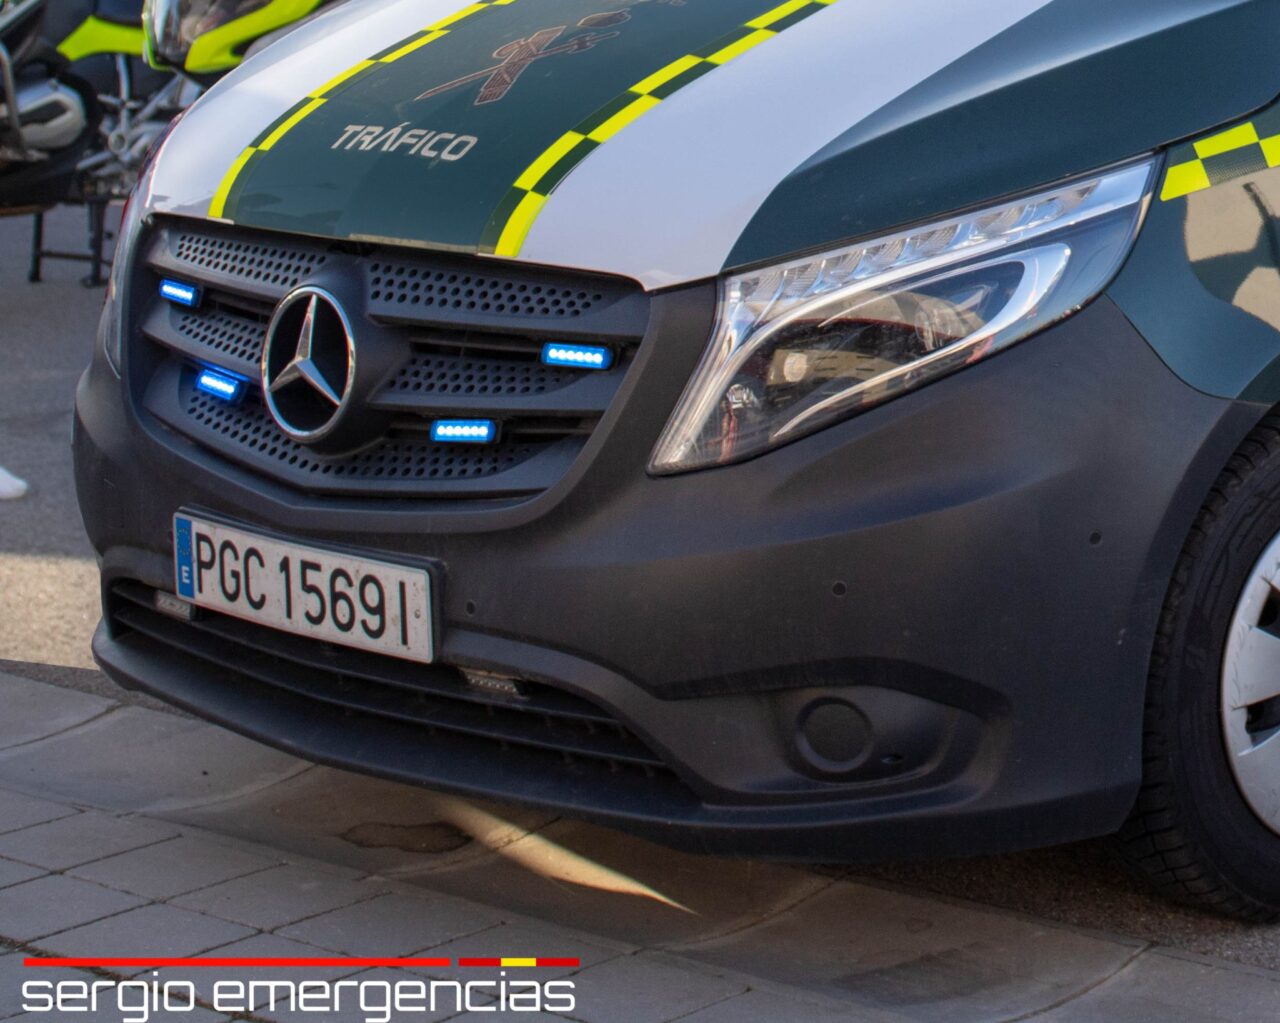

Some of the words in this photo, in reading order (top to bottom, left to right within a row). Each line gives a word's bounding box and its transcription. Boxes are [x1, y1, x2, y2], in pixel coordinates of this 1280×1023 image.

[330, 121, 479, 163] TRÁFICO
[181, 564, 191, 584] E
[195, 531, 267, 611] PGC
